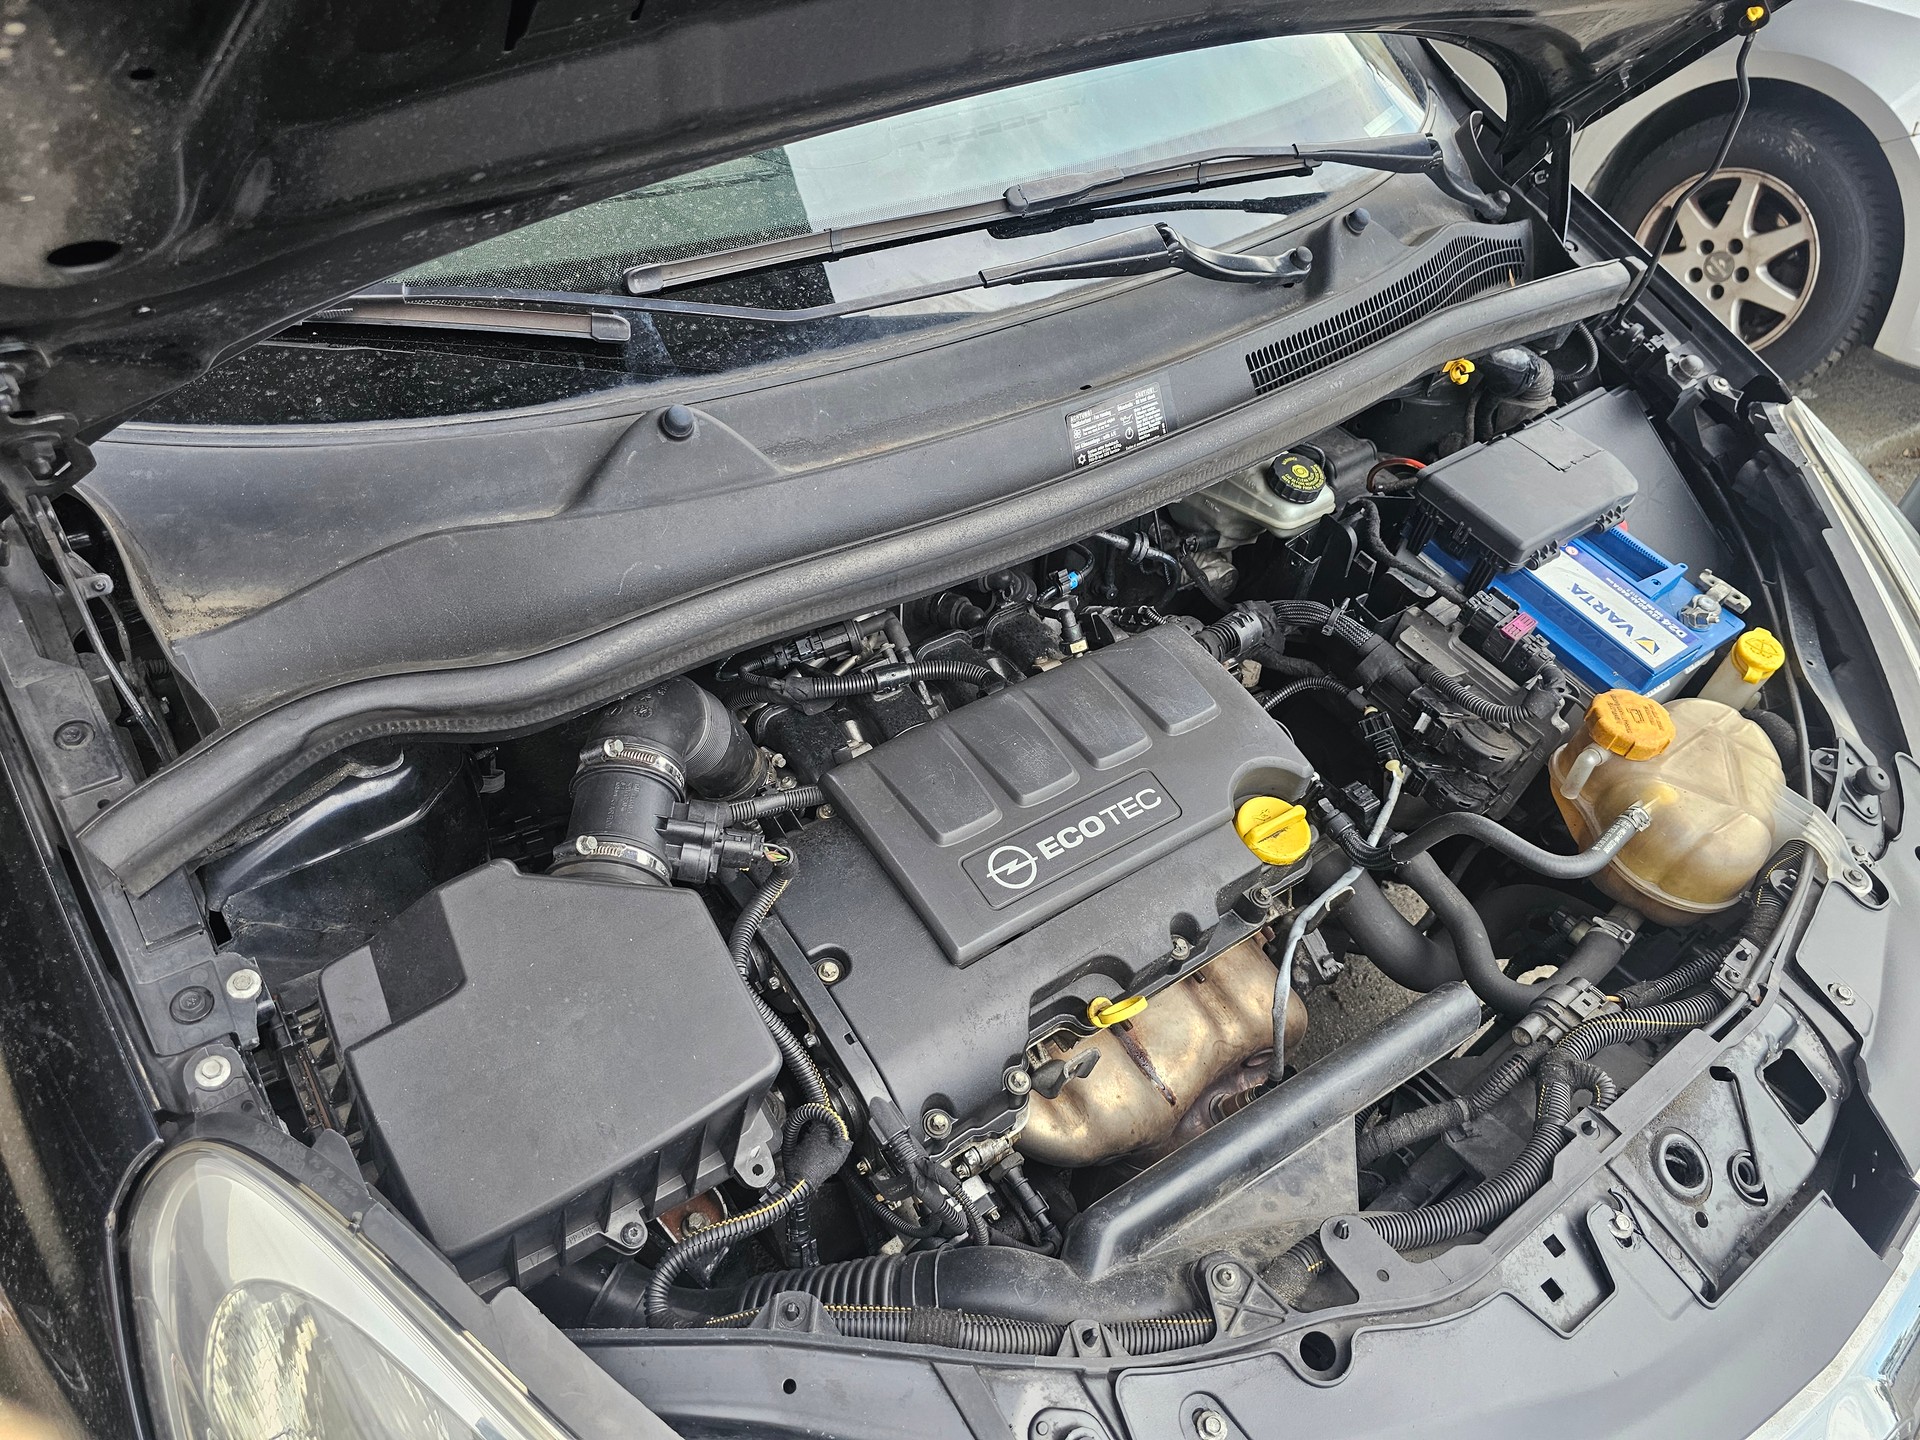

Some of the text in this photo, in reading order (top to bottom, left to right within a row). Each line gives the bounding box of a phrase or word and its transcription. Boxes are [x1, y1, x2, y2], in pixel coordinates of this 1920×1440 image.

[1570, 583, 1634, 637] VARTA
[1661, 618, 1687, 638] D24
[1036, 788, 1161, 860] ECOTEC
